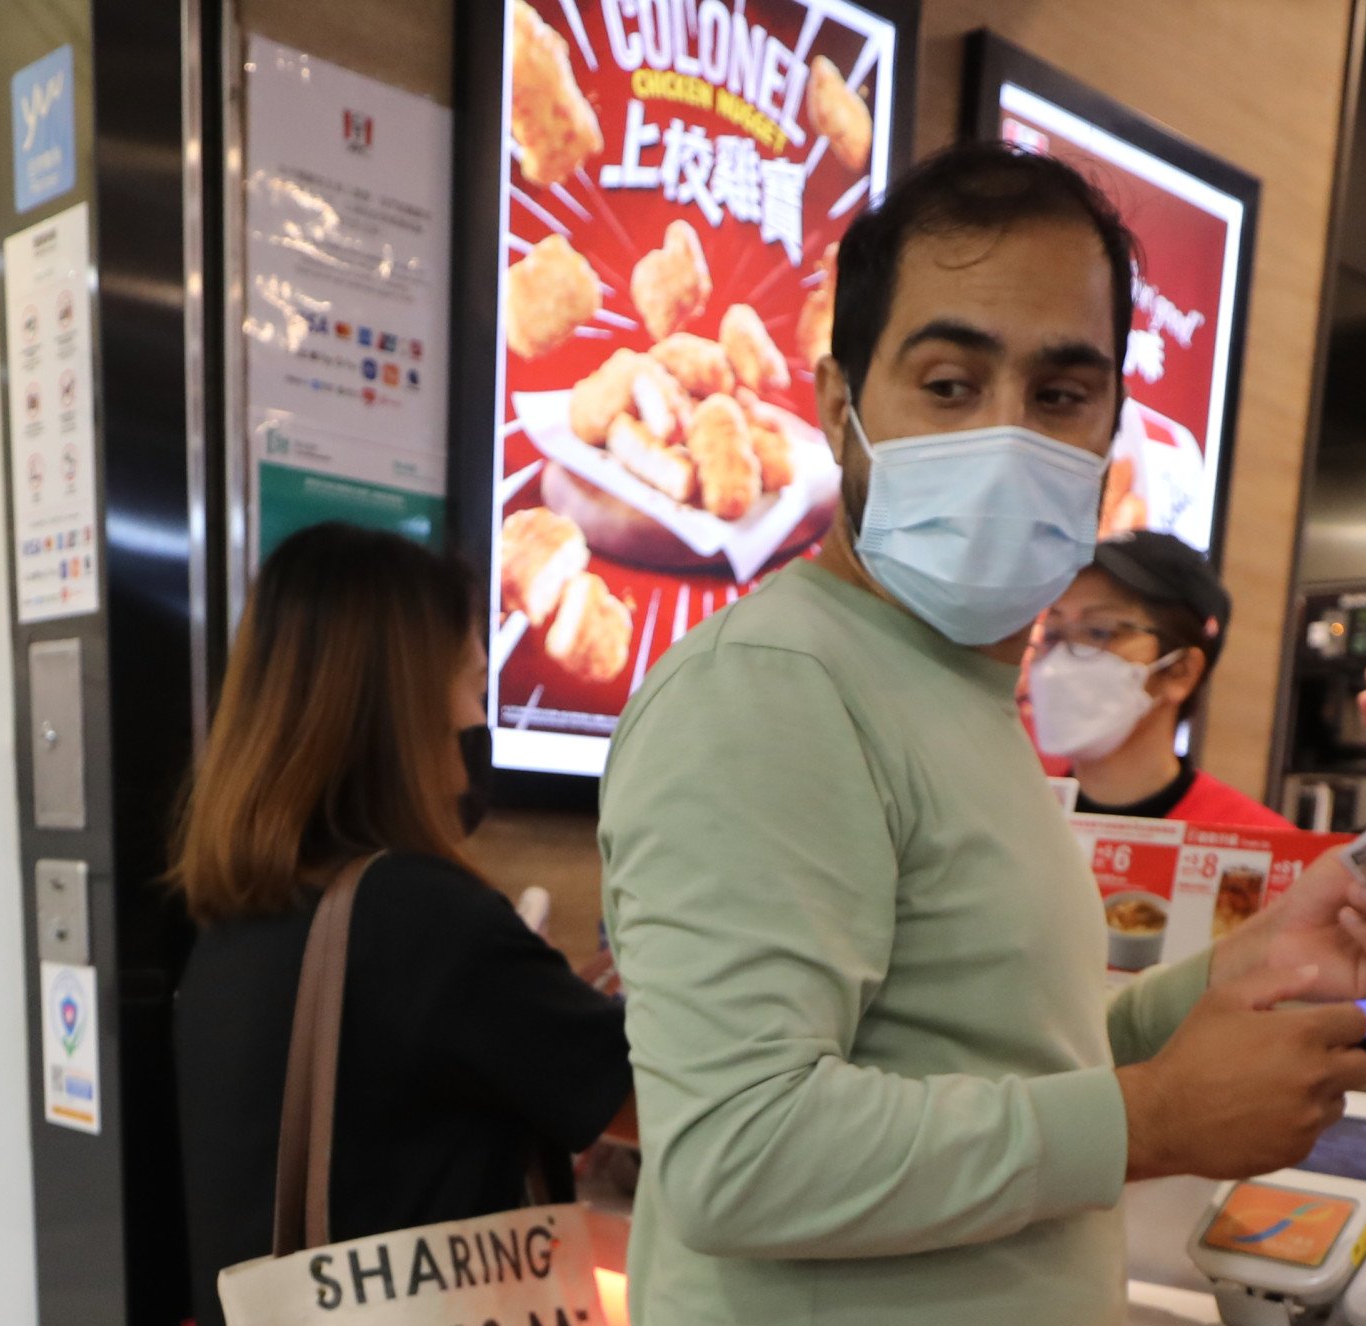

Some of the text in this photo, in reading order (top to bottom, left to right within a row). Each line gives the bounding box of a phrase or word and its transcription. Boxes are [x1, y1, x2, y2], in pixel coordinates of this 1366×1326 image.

[601, 0, 809, 147] COLONEL
[631, 67, 714, 111] CHICKEN
[308, 1227, 556, 1311] SHARING
